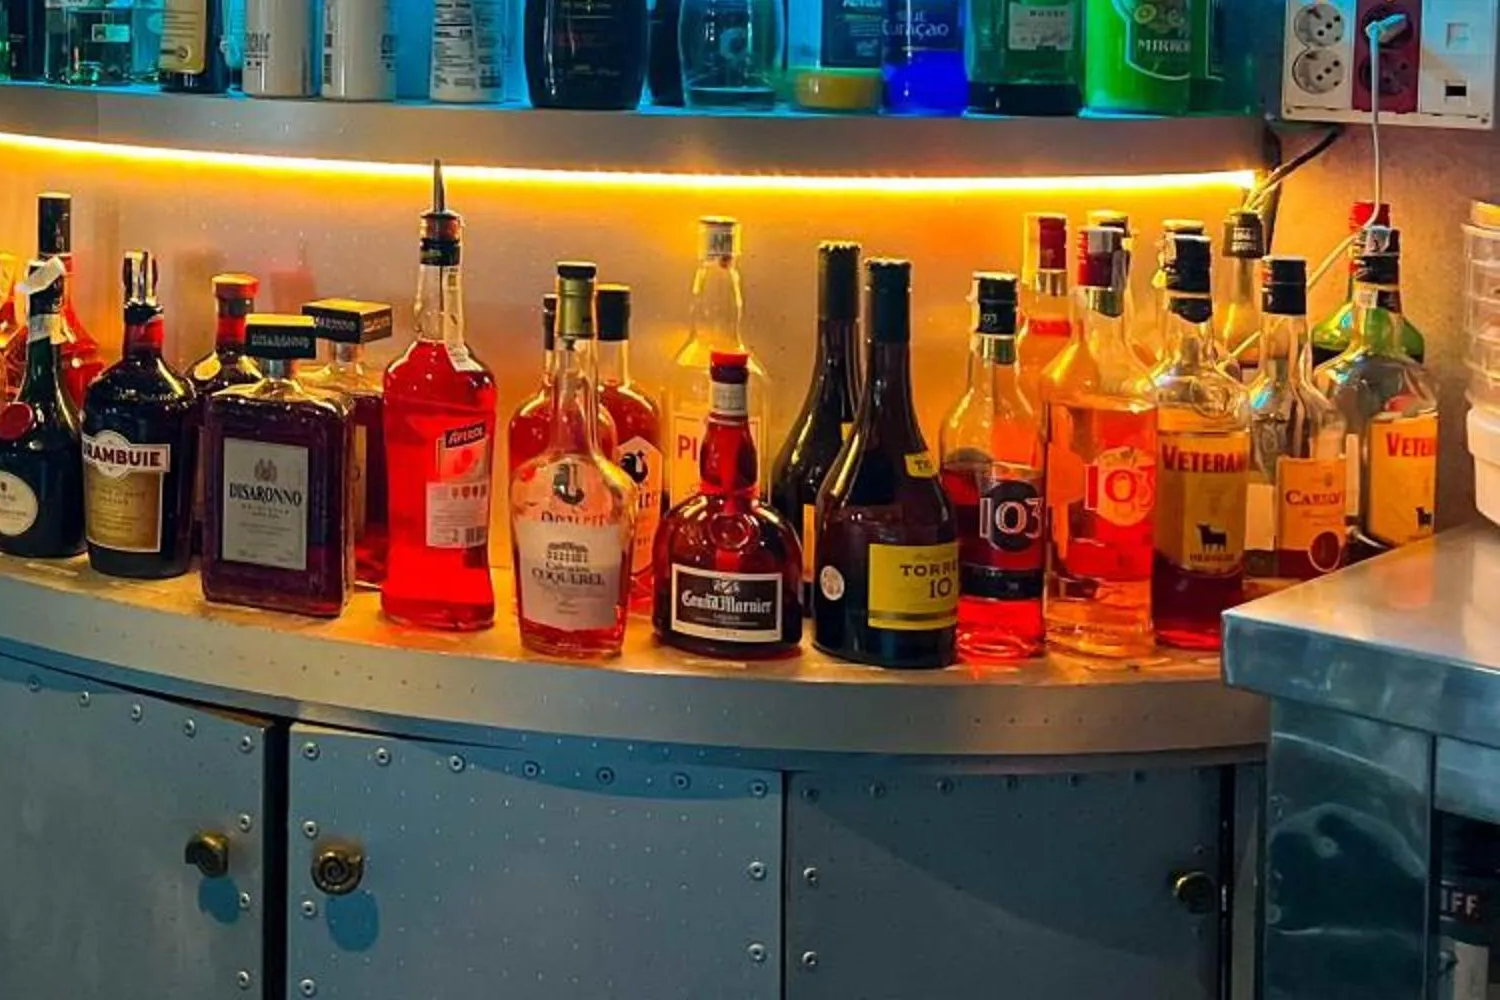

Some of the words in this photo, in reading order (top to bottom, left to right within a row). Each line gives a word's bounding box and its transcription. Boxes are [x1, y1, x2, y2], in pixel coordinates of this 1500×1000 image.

[229, 481, 302, 508] DISARONNO
[979, 497, 1044, 540] 103
[929, 576, 954, 599] 10
